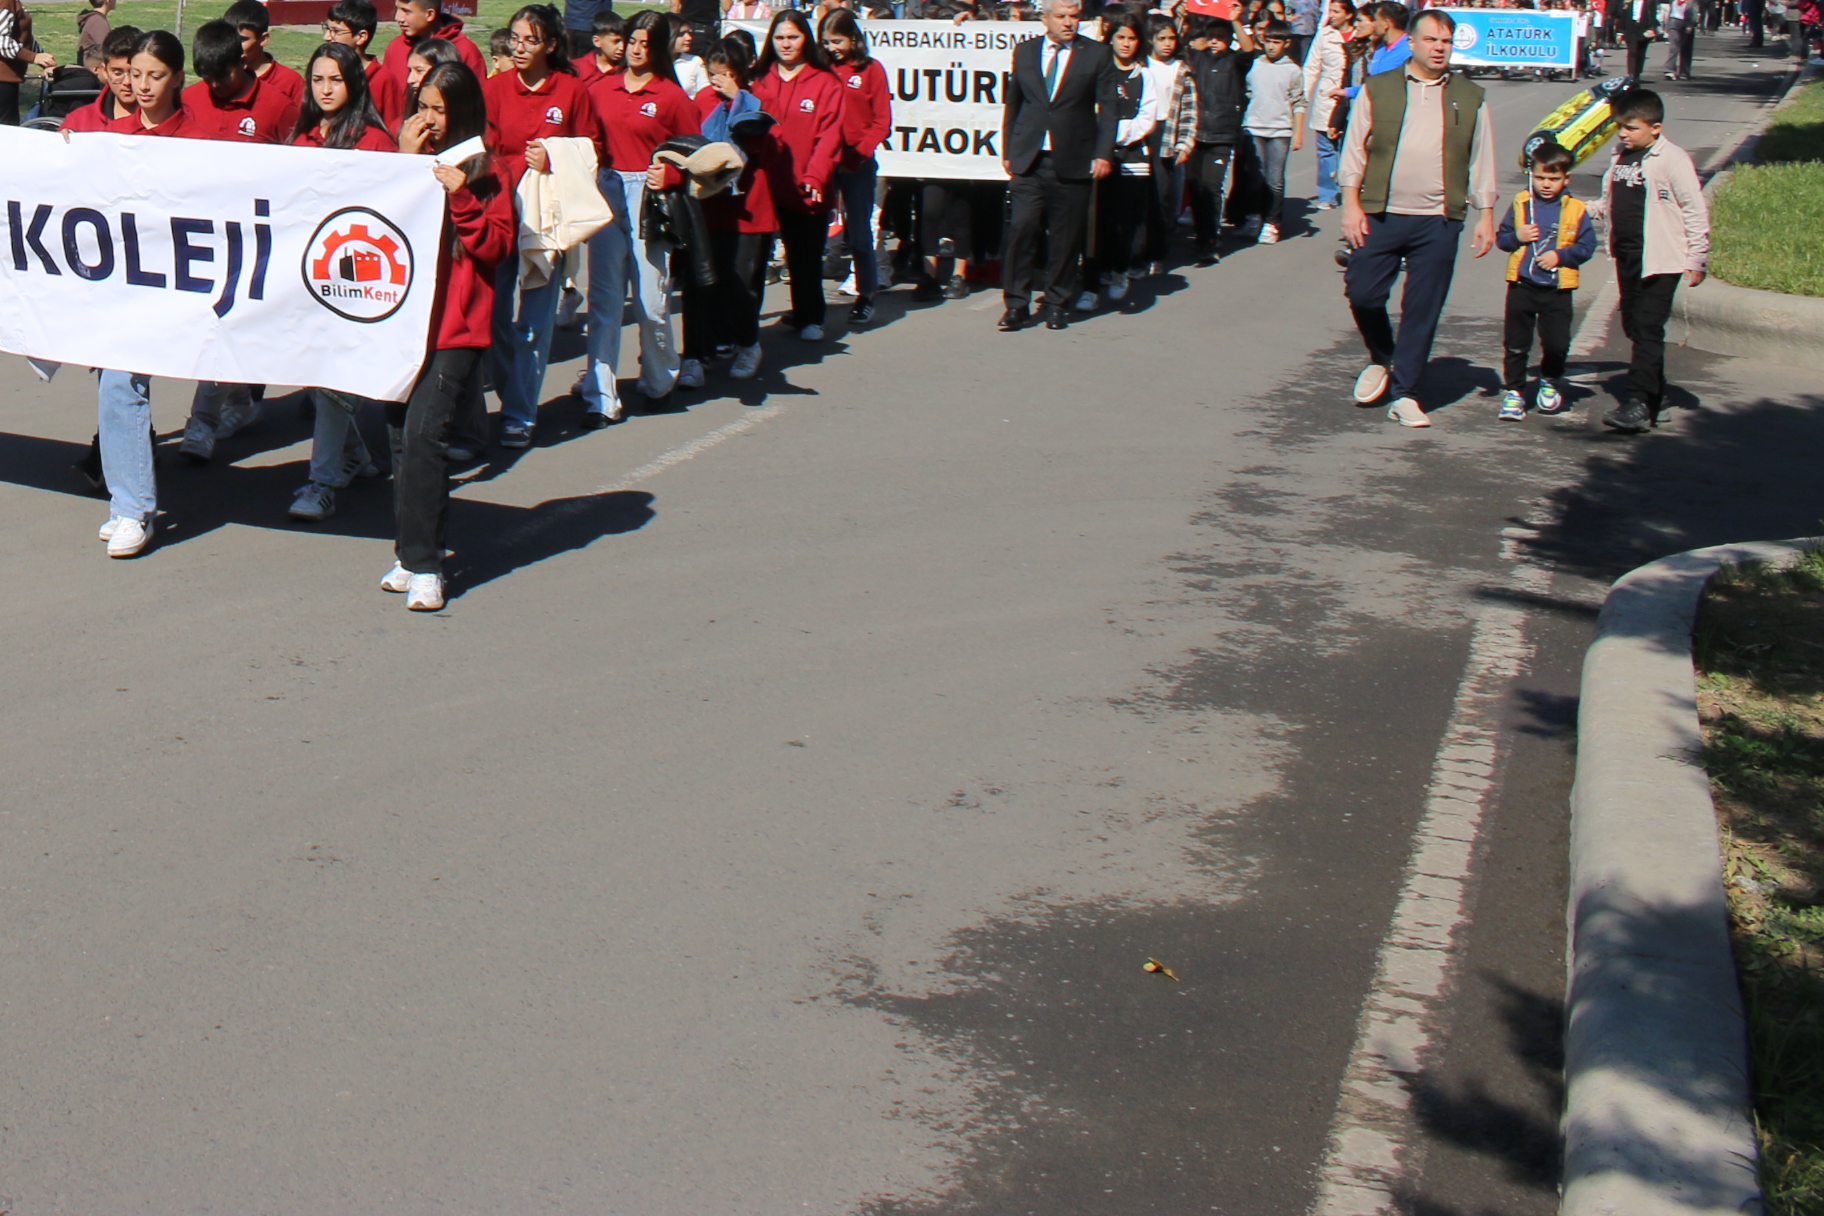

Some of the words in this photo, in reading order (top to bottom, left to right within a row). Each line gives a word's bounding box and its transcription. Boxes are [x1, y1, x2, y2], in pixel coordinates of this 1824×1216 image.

[1487, 25, 1553, 40] ATATÜRK
[1486, 41, 1556, 57] İLKOKULU
[890, 62, 1008, 104] UTÜR
[881, 126, 999, 157] TAOK
[7, 198, 272, 319] KOLEJİ
[320, 284, 399, 304] BilimKent
